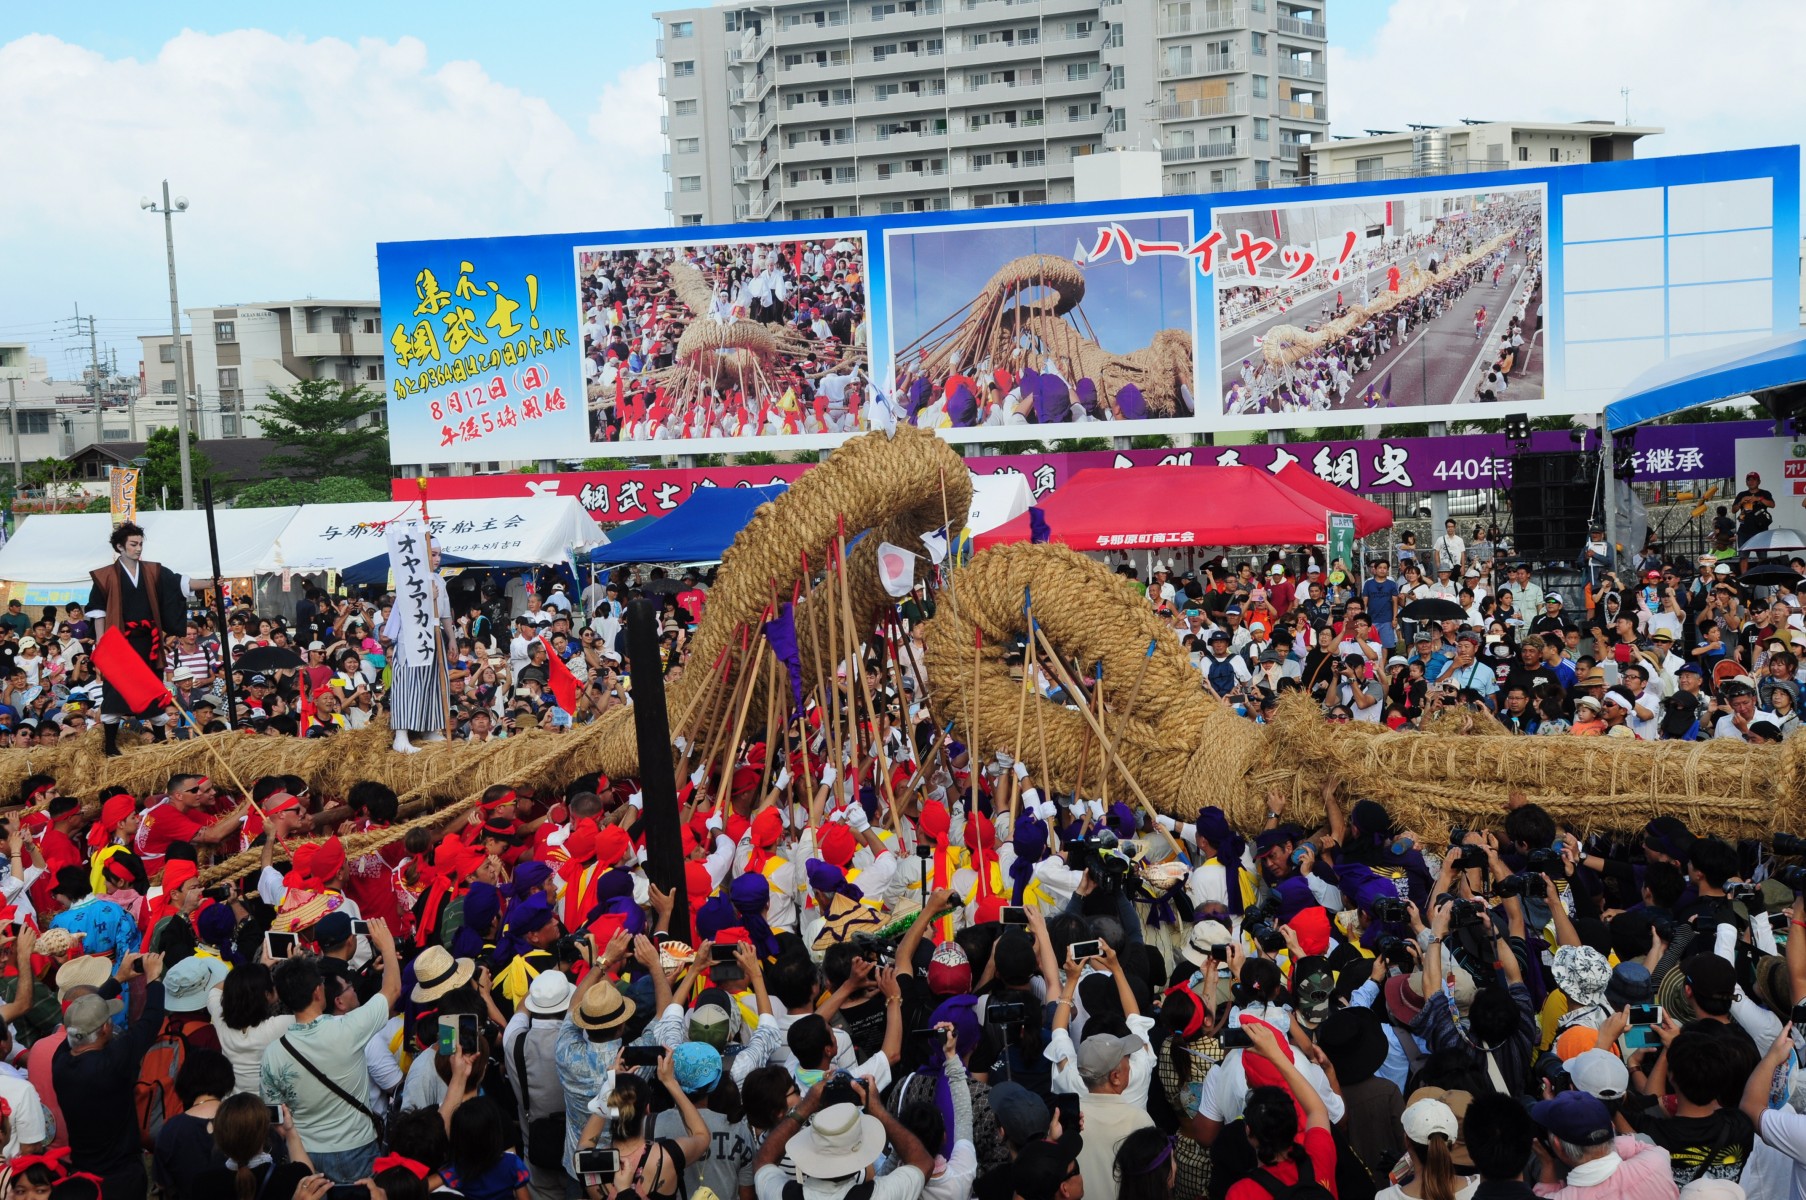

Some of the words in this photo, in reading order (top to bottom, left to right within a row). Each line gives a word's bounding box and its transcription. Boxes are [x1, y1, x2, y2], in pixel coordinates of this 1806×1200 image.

[439, 386, 567, 447] 午後5時開始
[1431, 457, 1513, 483] 440年
[1785, 463, 1806, 476] オリ
[319, 514, 526, 540] 与那原原船主会
[1096, 531, 1195, 547] 与那原町商工会
[397, 534, 434, 661] オヤケアカハチ
